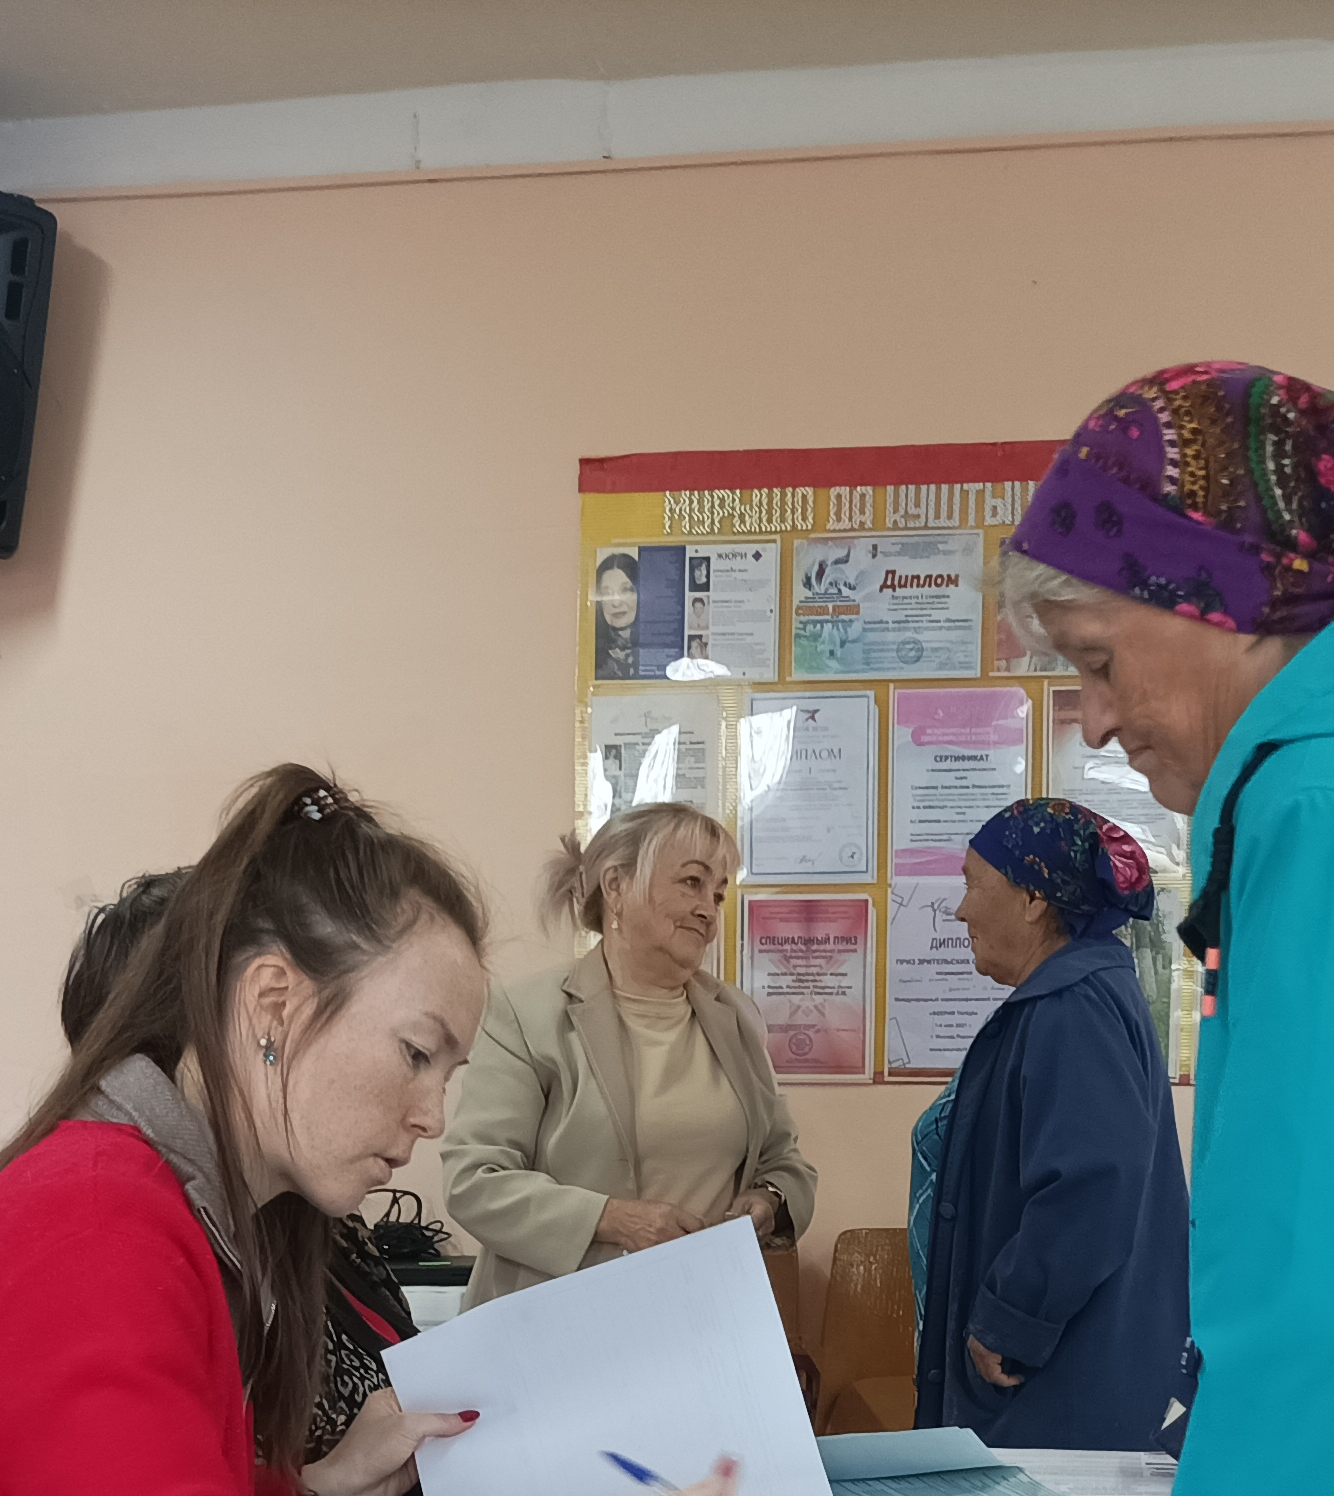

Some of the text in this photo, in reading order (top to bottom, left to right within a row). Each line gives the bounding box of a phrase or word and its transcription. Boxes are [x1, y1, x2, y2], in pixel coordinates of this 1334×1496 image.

[826, 485, 874, 530] ДА
[879, 569, 960, 593] Диплом
[789, 748, 842, 760] ИПЛОМ
[934, 754, 989, 763] СЕРТИФИКАТ
[759, 933, 858, 947] СПЕЦИАЛЬНЫЙ ПРИЗ
[930, 937, 970, 950] ДИПЛО
